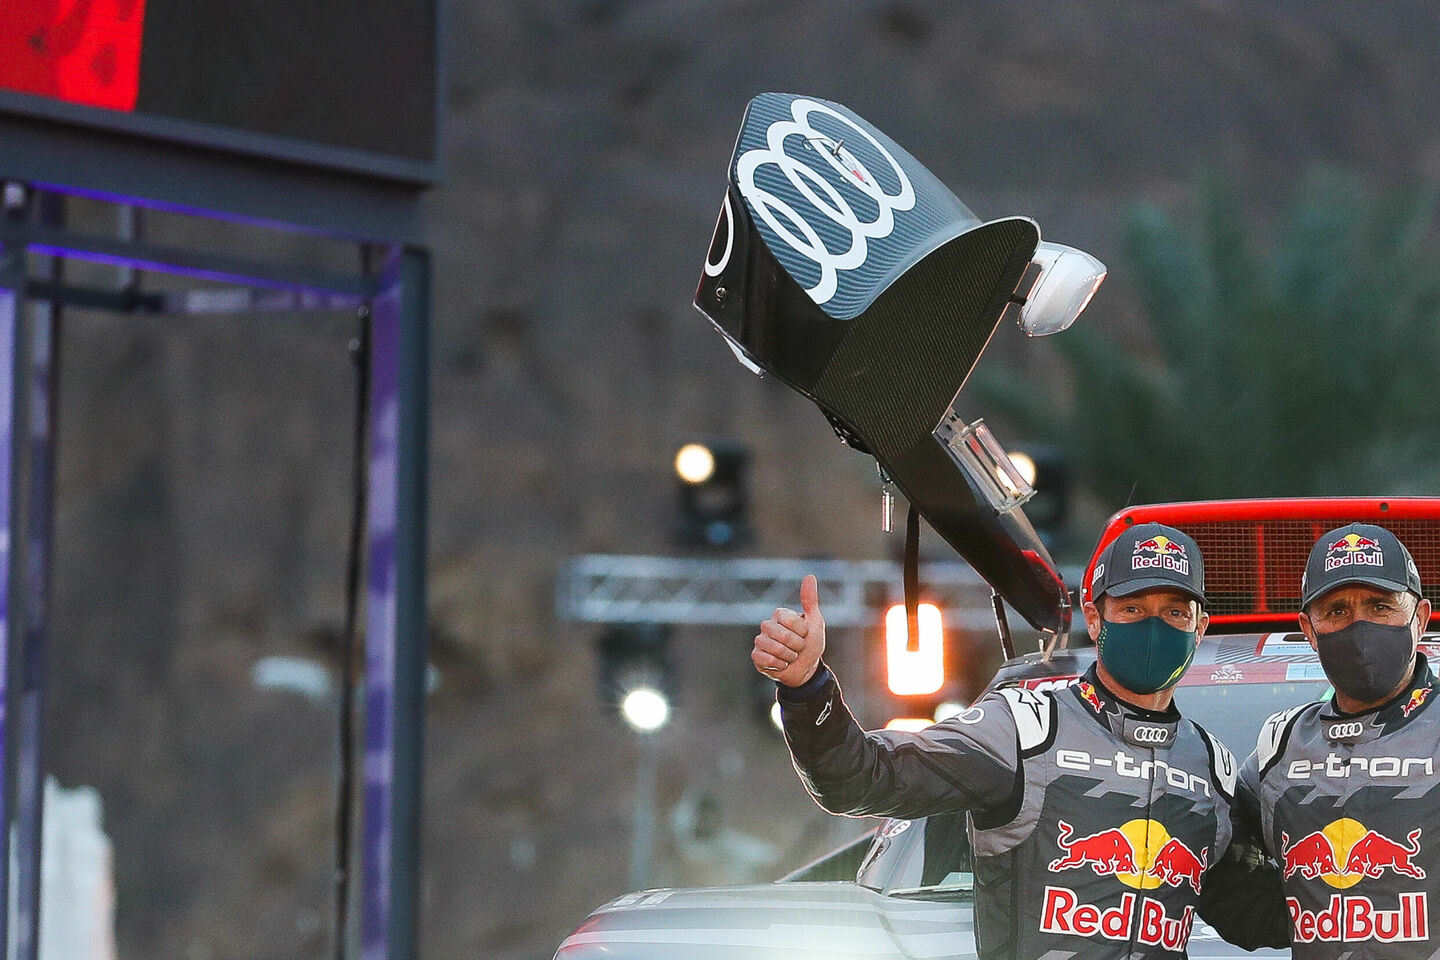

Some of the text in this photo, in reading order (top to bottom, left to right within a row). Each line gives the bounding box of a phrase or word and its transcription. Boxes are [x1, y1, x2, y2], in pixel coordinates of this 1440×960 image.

[1132, 554, 1189, 575] Red Bull
[1325, 551, 1383, 571] Red Bull
[1056, 749, 1211, 797] e-tron
[1286, 753, 1434, 780] e-tron
[1039, 885, 1136, 941] Red
[1343, 891, 1429, 942] Bull
